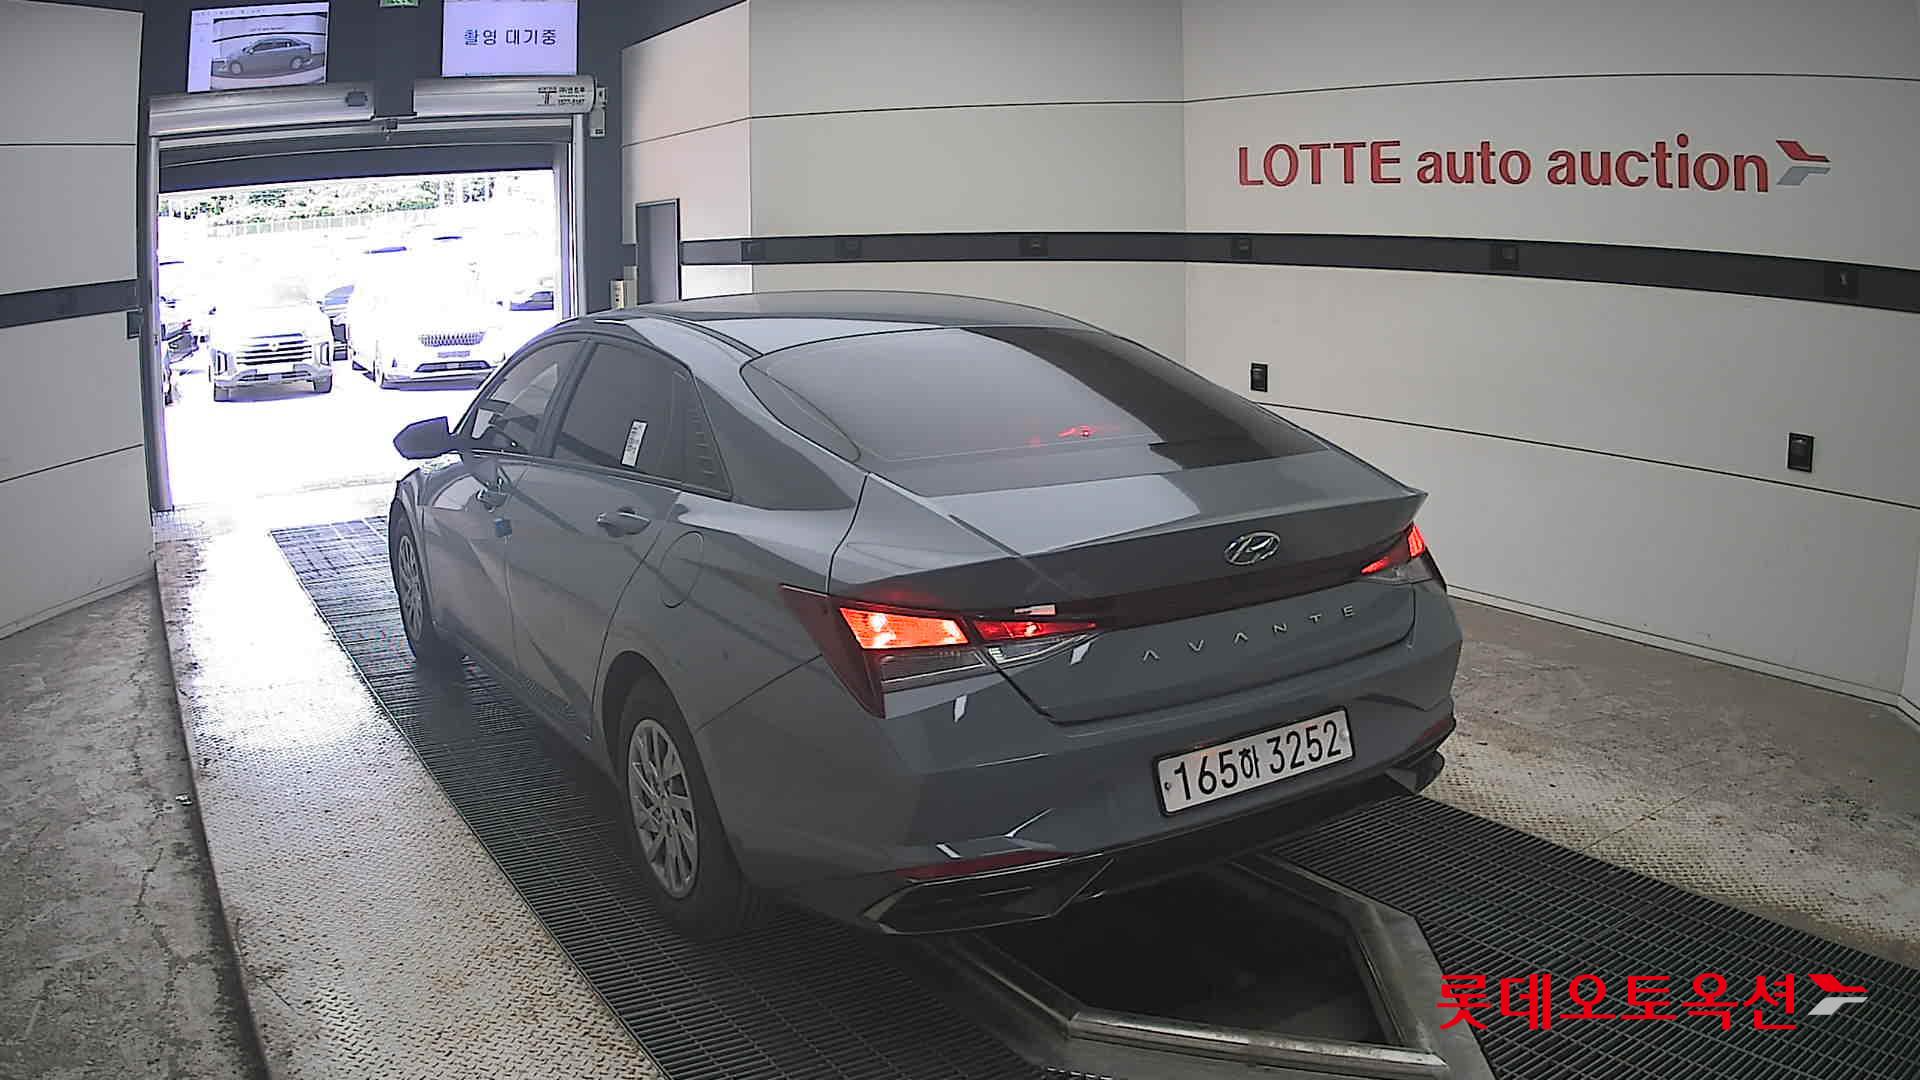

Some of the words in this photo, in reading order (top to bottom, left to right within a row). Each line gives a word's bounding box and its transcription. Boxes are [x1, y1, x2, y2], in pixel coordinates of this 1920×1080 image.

[505, 29, 556, 46] 대기중
[1239, 140, 1401, 187] LOTTE
[1416, 140, 1532, 185] auto
[1547, 133, 1769, 192] auction
[1142, 603, 1357, 662] AVANTE
[1174, 744, 1260, 801] 165하
[1266, 719, 1342, 775] 3252
